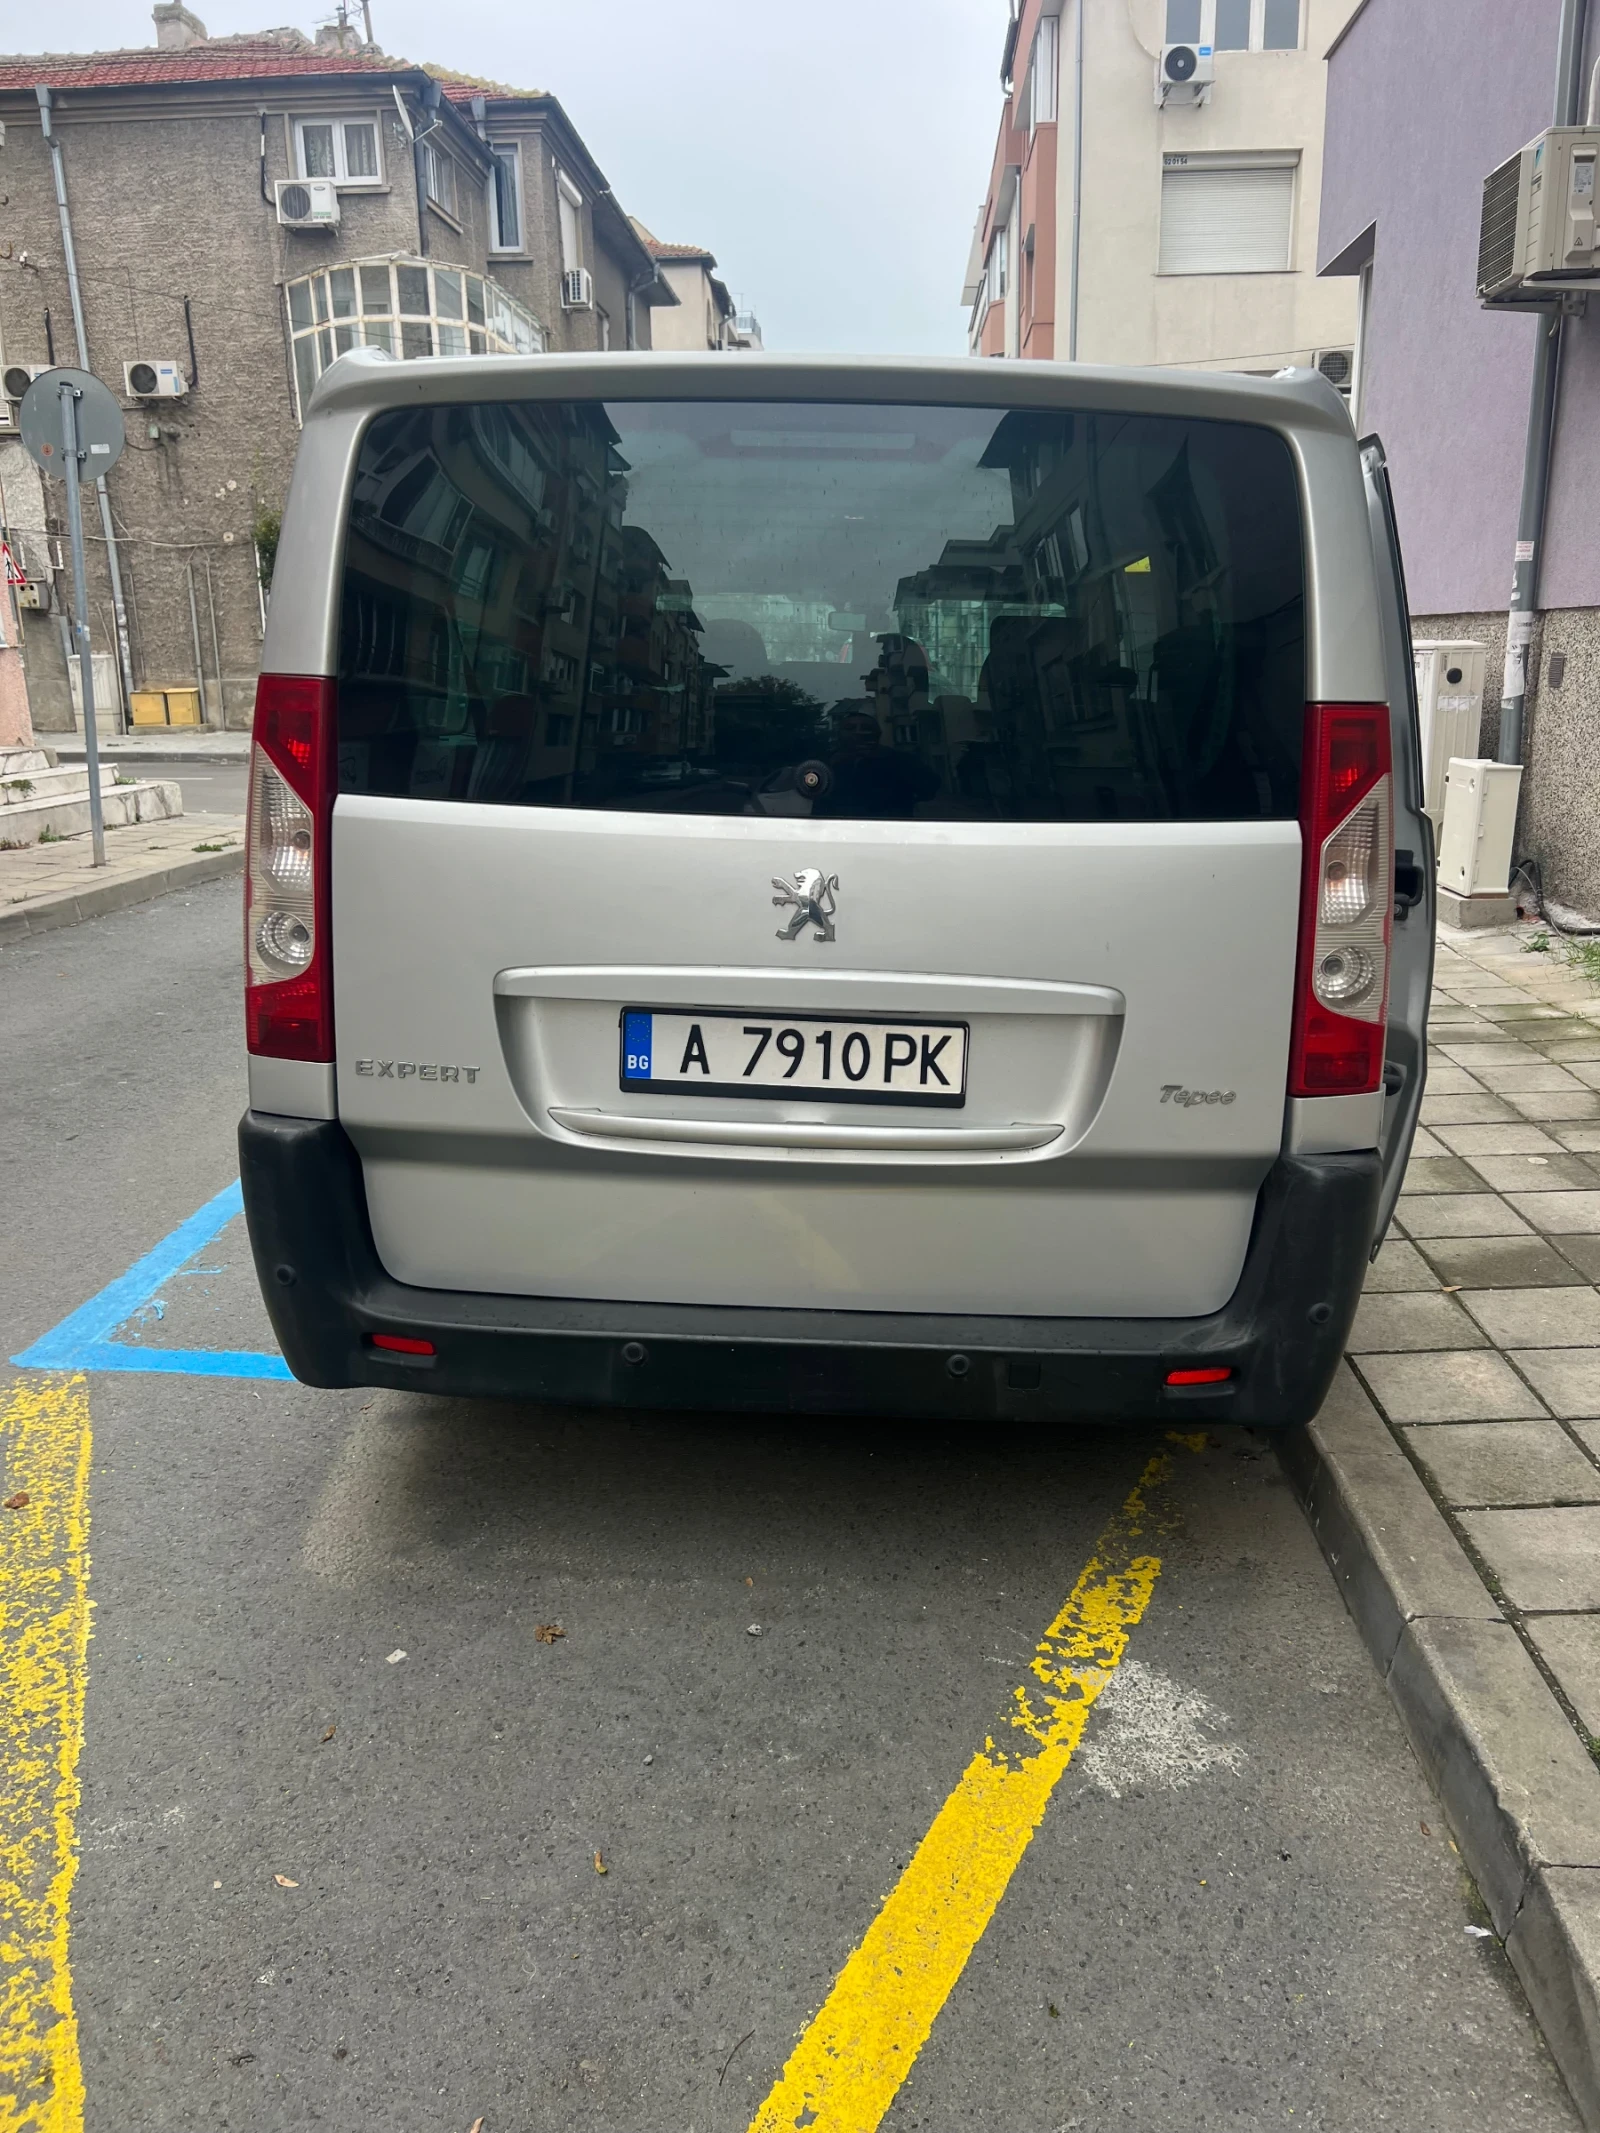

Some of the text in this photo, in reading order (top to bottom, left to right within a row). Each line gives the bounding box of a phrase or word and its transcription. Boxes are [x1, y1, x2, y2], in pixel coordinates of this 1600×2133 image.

[627, 1054, 649, 1070] BG
[679, 1024, 710, 1075] A
[742, 1026, 871, 1081] 7910
[355, 1058, 481, 1084] EXPERT
[1160, 1084, 1237, 1108] Tepee
